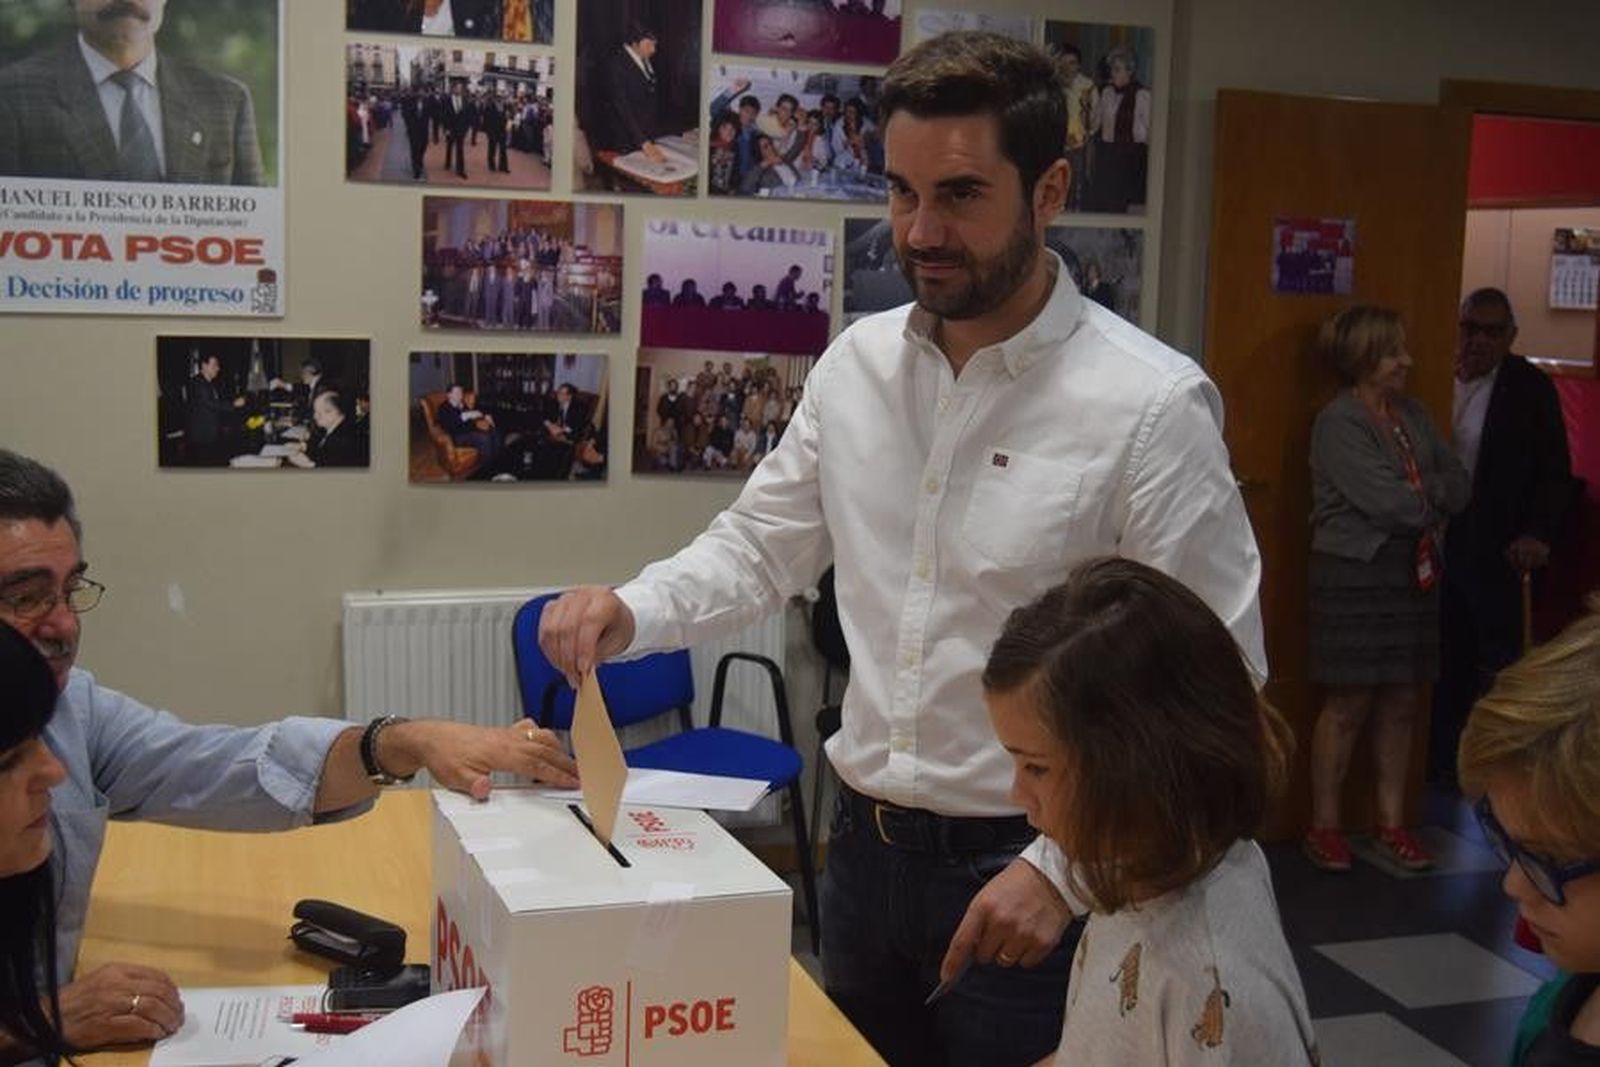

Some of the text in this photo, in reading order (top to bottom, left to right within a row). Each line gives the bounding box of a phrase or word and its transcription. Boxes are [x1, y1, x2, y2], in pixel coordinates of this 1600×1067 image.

[83, 191, 157, 210] RIESCO
[162, 194, 257, 212] BARRERO
[126, 234, 266, 266] PSOE
[7, 275, 245, 307] Decisión de progreso
[645, 997, 736, 1040] PSOE
